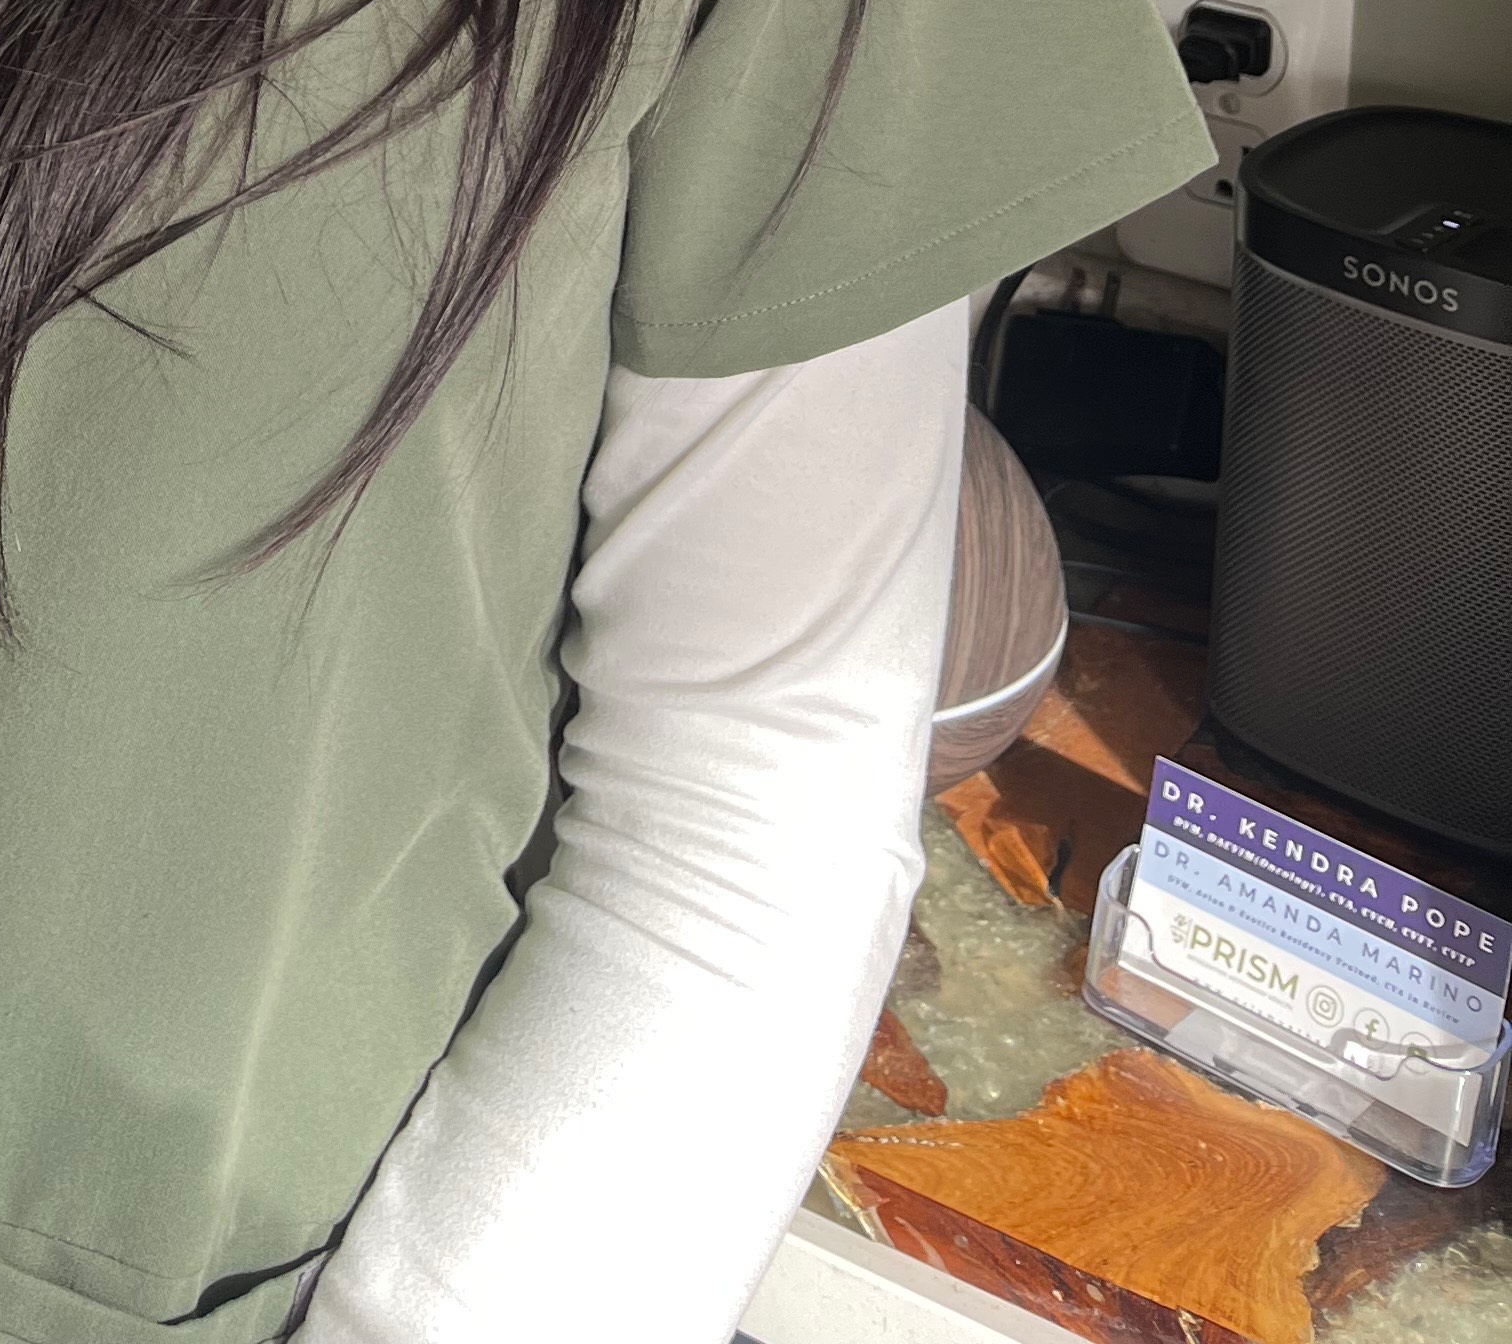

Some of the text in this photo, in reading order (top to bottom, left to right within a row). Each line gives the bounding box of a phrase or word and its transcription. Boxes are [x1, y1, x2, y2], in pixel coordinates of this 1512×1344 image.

[1343, 255, 1460, 312] SONOS
[1154, 840, 1200, 876] DR.
[1218, 873, 1342, 946] AMANDA
[1361, 942, 1483, 1013] MARINO
[1162, 780, 1496, 954] DR. KENDRA POPE
[1190, 923, 1300, 1001] PRISM
